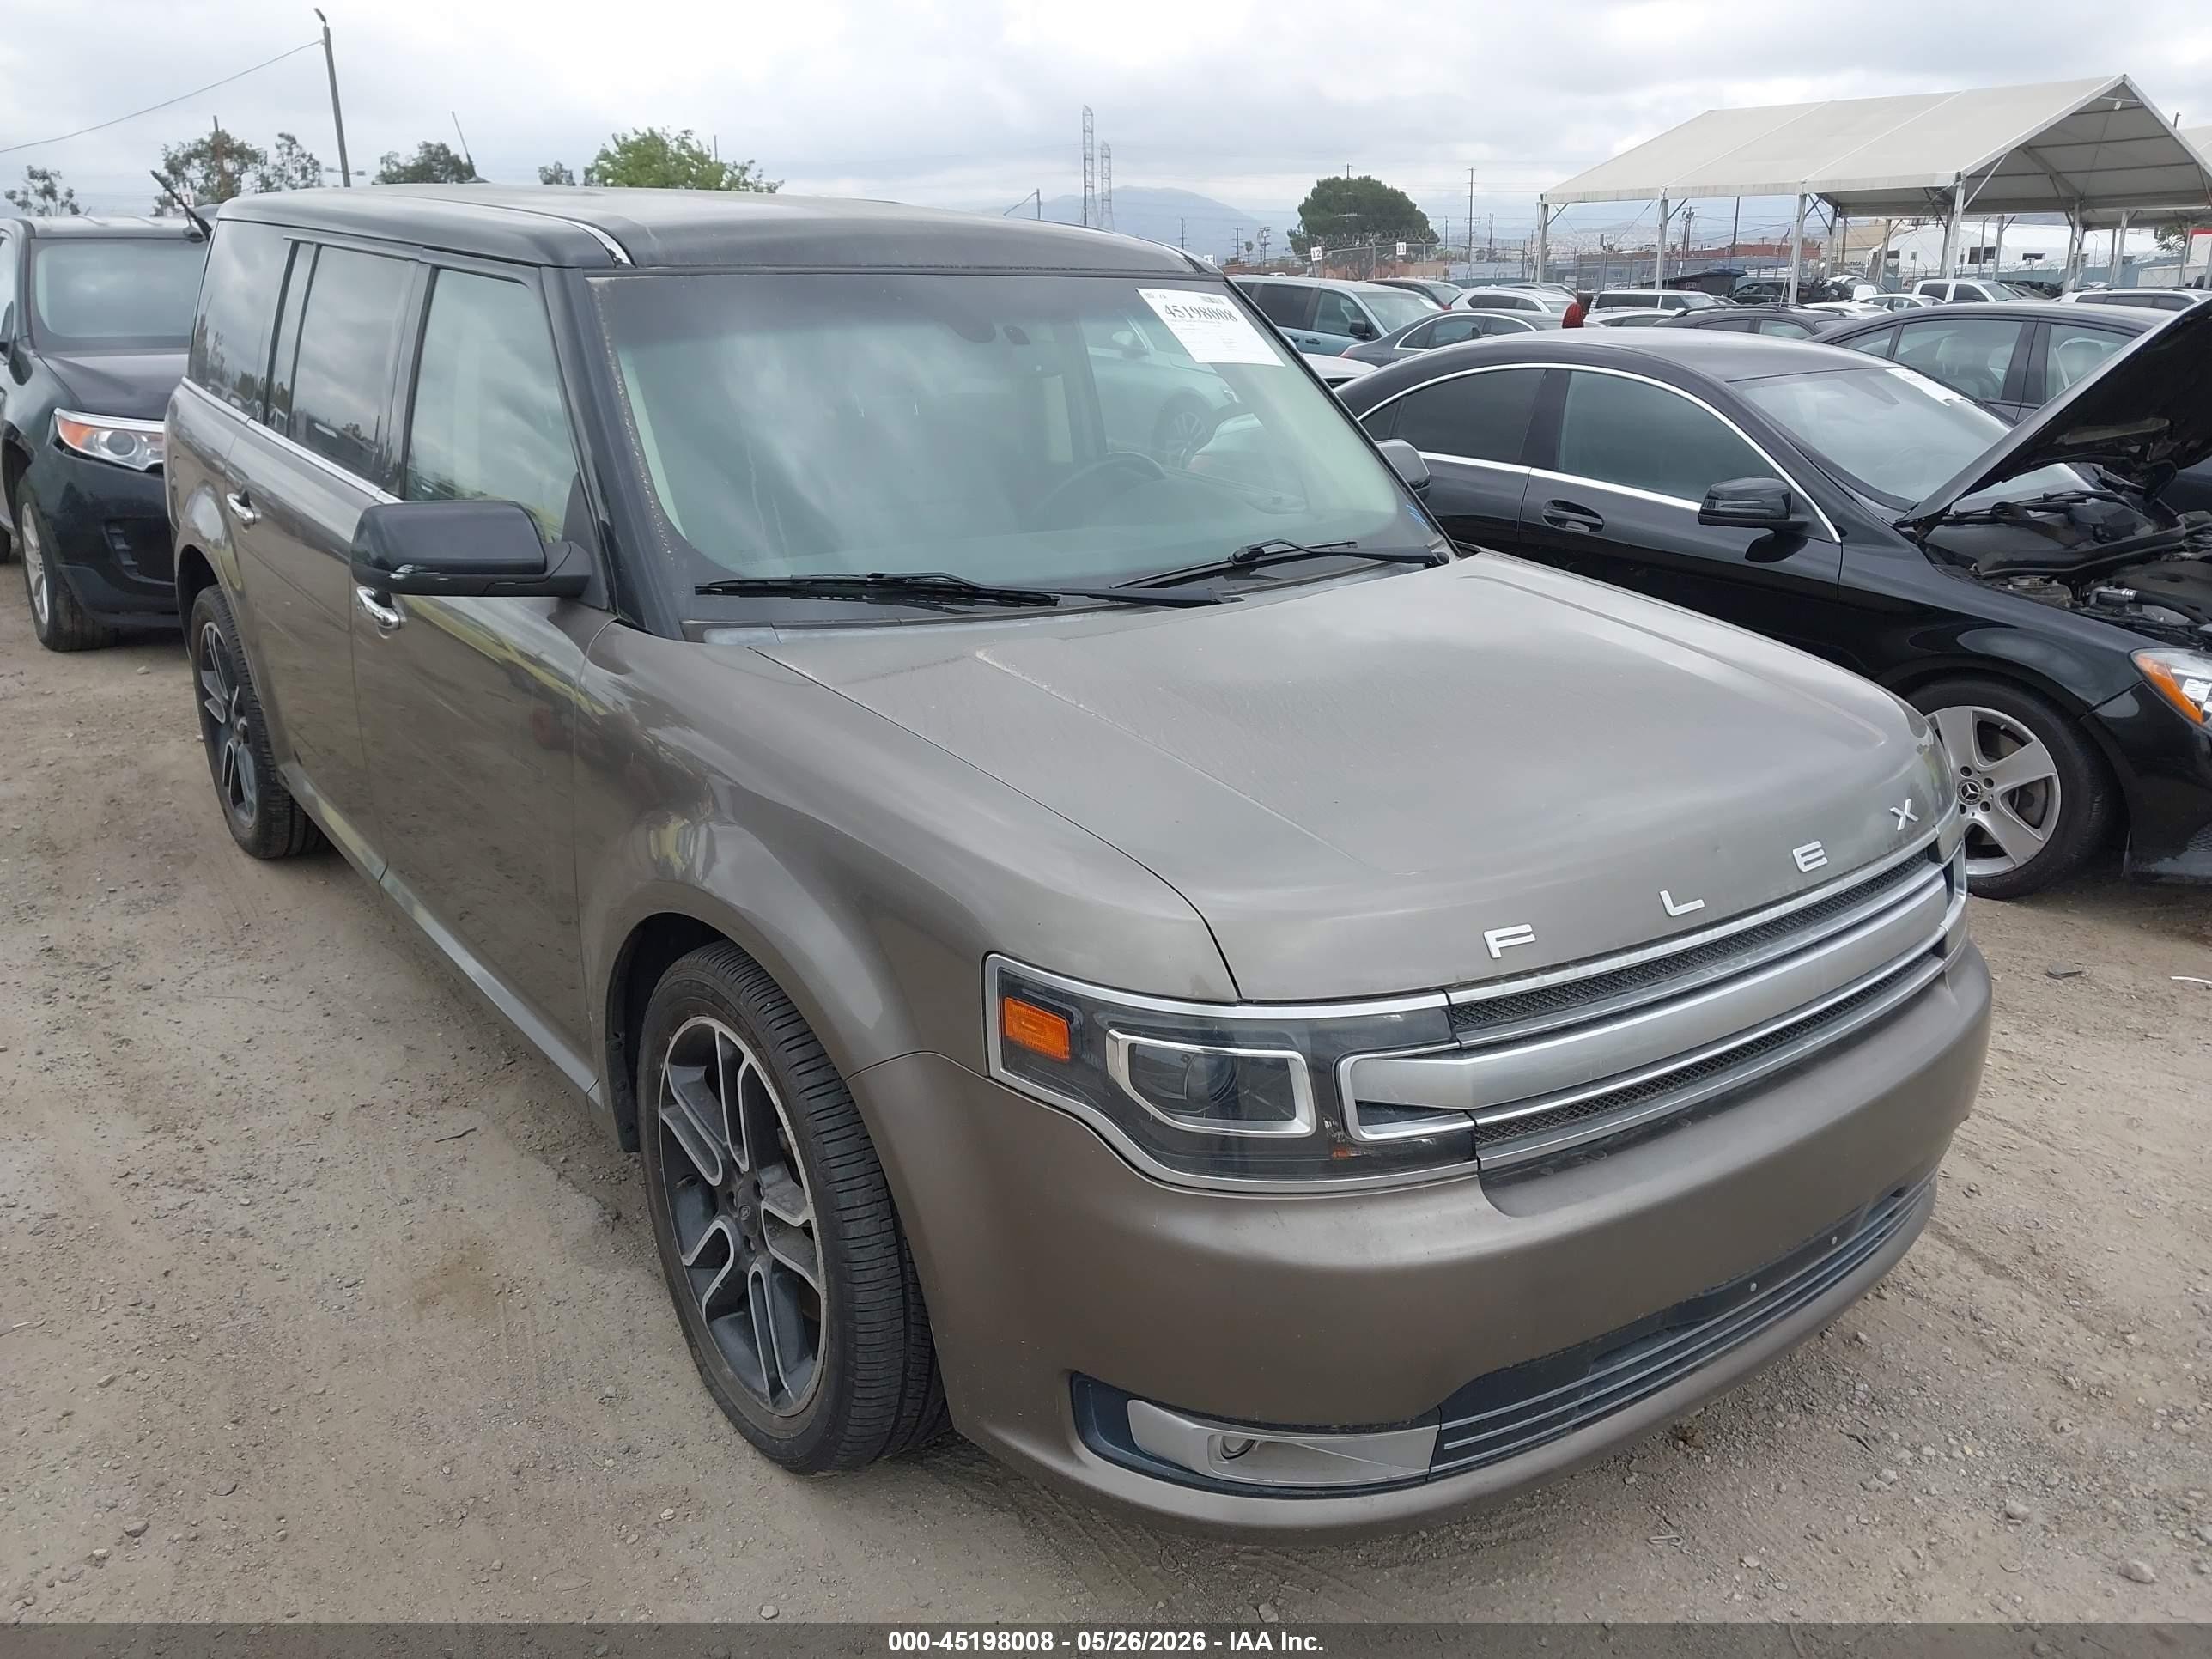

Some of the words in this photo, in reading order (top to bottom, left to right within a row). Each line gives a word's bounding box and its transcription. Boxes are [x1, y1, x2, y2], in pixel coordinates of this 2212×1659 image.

[1312, 249, 1322, 258] 12
[1397, 244, 1407, 253] 11
[1164, 303, 1238, 323] 45198008
[1483, 799, 1919, 959] FLEX
